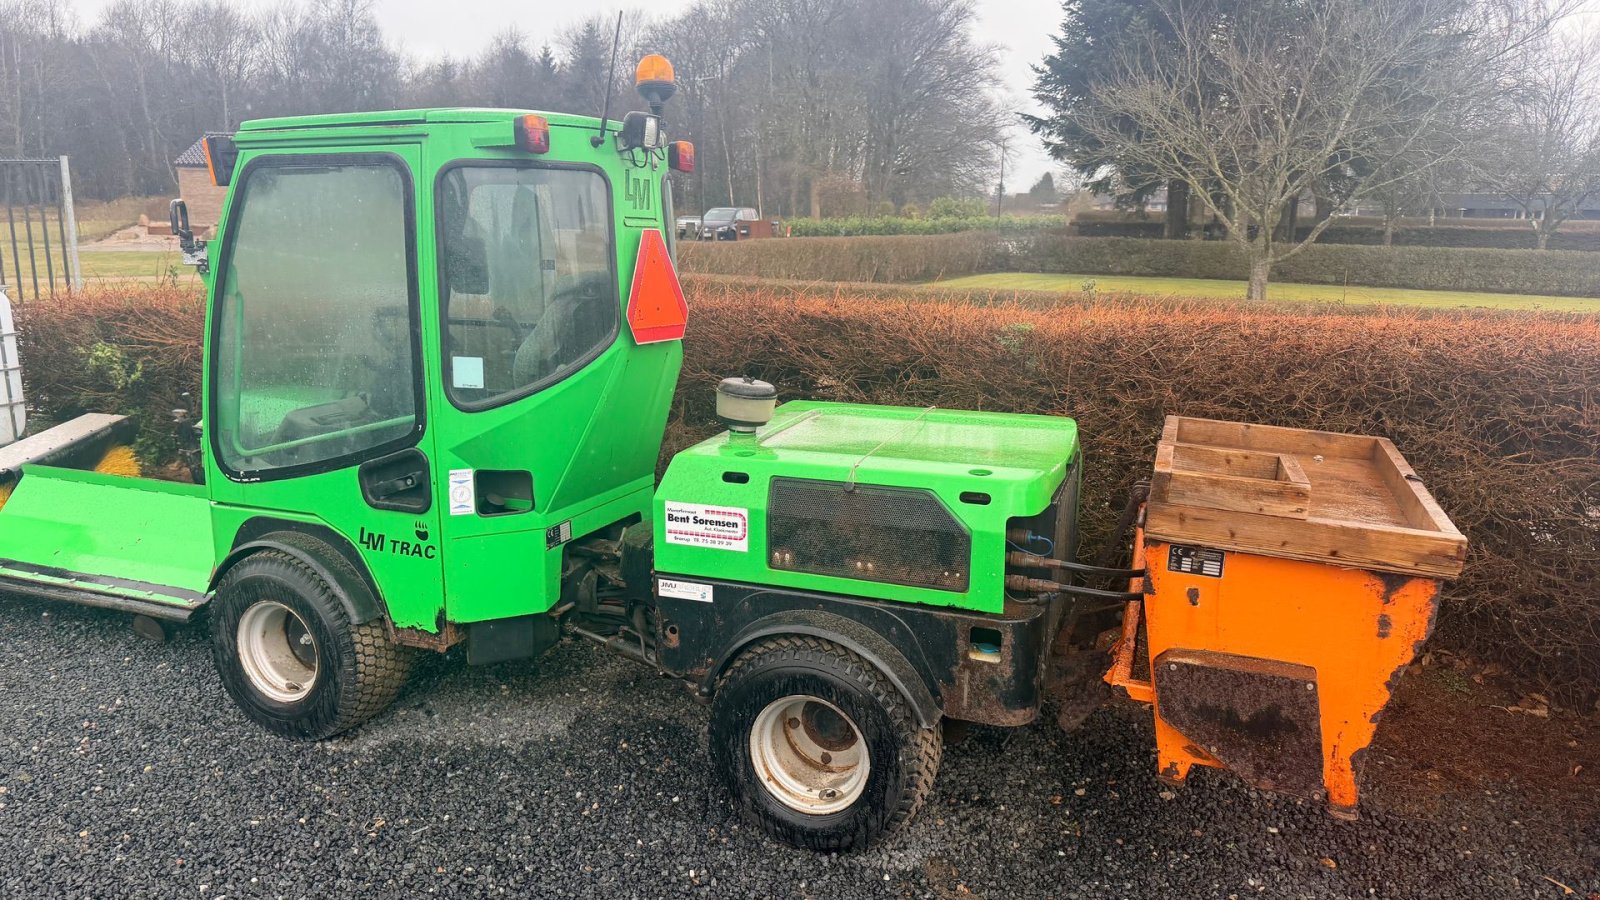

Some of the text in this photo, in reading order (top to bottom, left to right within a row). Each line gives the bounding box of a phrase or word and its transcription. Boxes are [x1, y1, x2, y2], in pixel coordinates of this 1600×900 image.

[624, 168, 651, 211] LM
[667, 513, 690, 523] Bent
[359, 526, 436, 559] LM TRAC
[1172, 547, 1183, 556] CE
